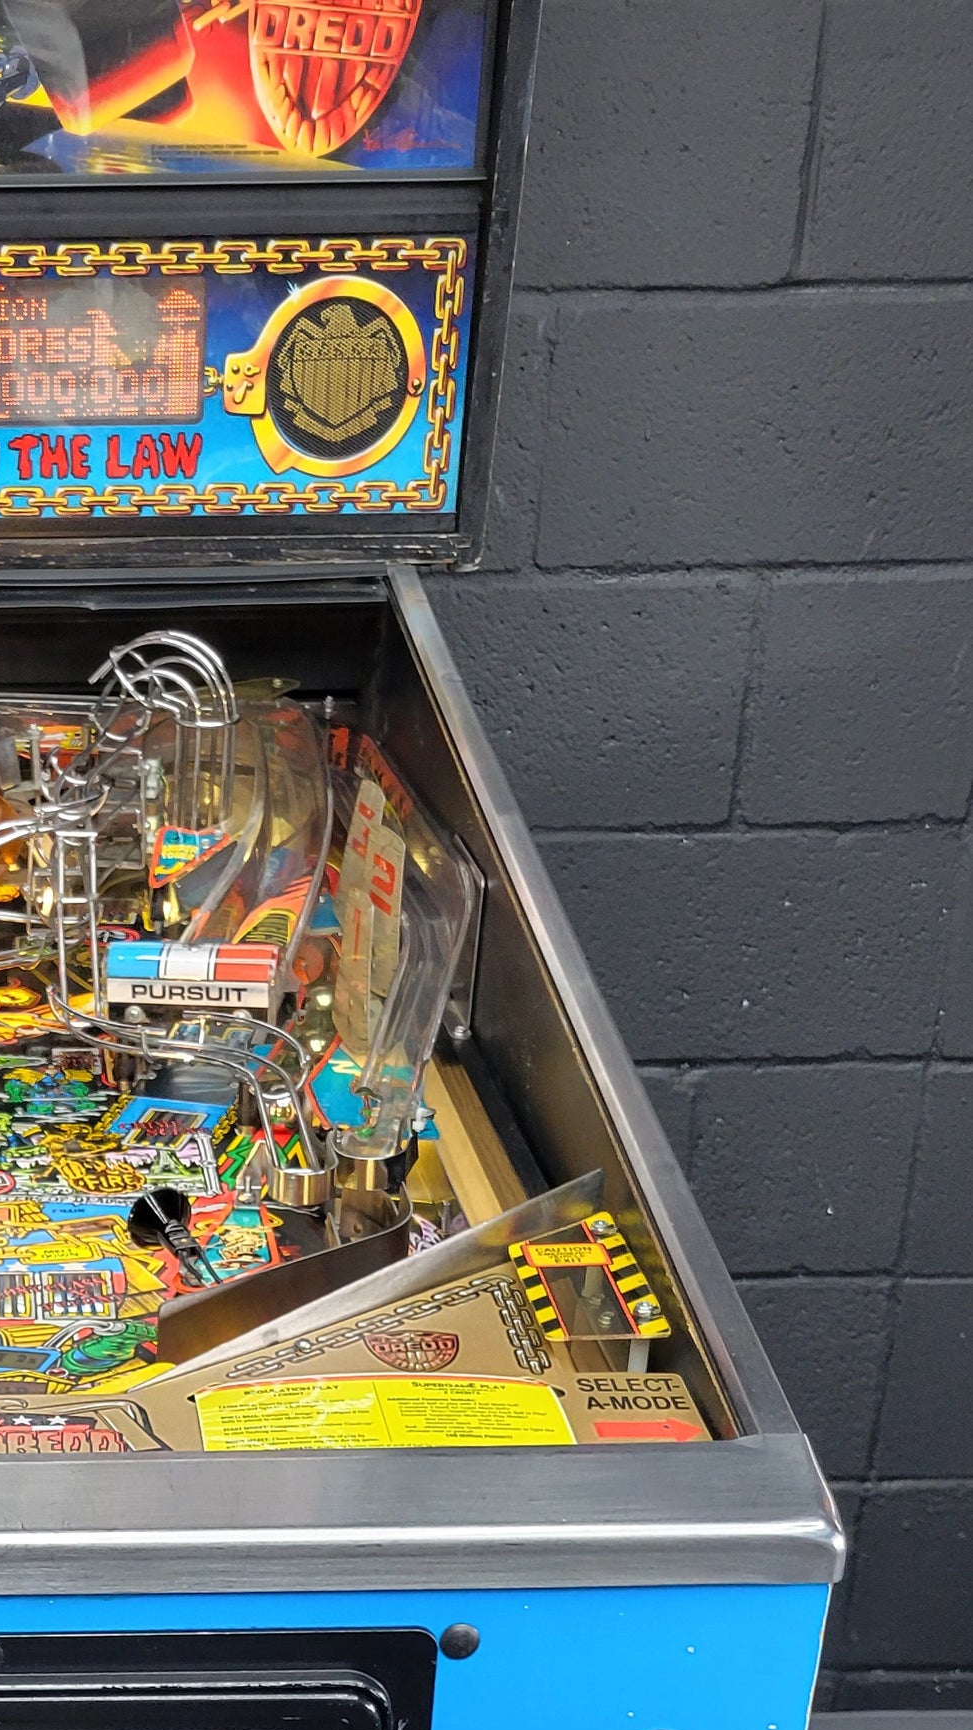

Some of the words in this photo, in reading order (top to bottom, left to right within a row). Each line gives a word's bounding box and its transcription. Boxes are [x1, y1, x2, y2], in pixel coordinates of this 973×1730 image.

[254, 4, 411, 58] DREDD
[8, 433, 92, 480] THE
[106, 433, 203, 479] LAW
[130, 984, 248, 1002] PURSUIT
[83, 1174, 136, 1191] FIRE
[372, 1339, 455, 1353] DREDD
[577, 1378, 680, 1393] SELECT-
[587, 1395, 691, 1411] A-MODE
